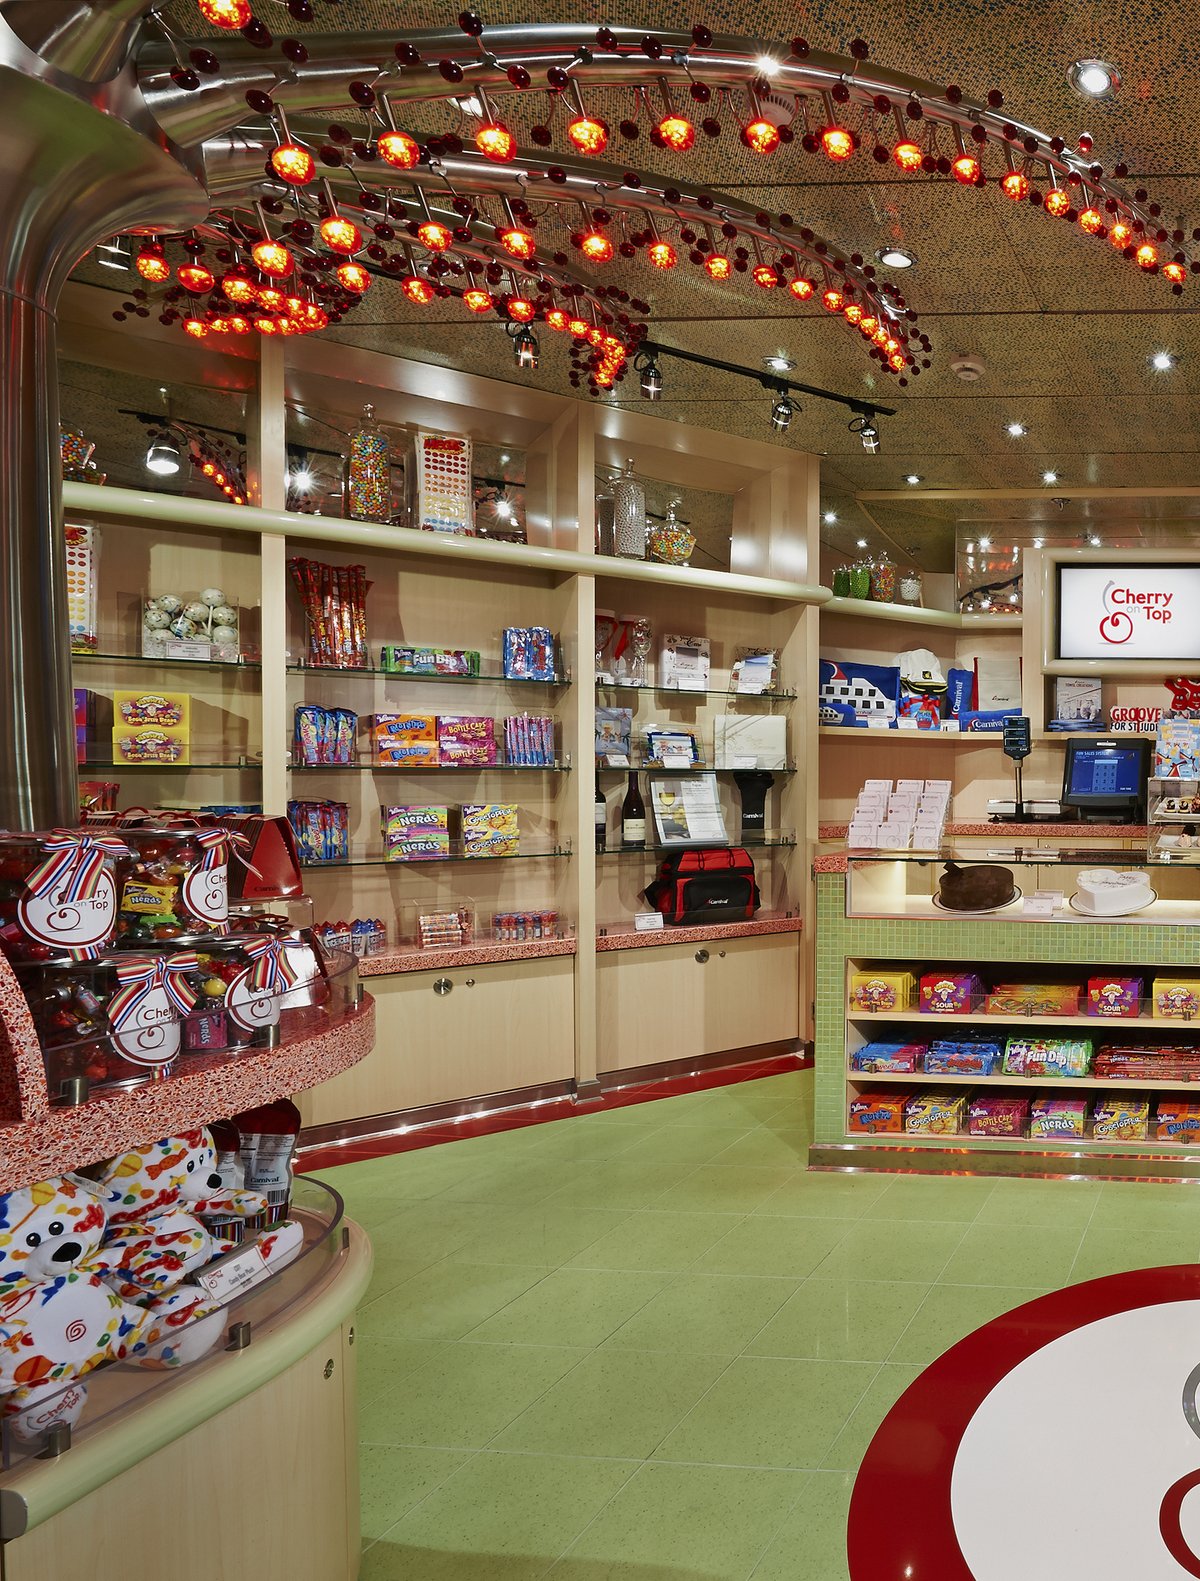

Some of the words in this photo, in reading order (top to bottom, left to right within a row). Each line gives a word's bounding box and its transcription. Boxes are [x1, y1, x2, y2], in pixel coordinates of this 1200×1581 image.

[1111, 588, 1174, 607] Cherry
[1142, 606, 1173, 624] Top
[413, 654, 435, 666] Fun
[953, 681, 963, 711] Carnival
[1111, 707, 1161, 722] GROOVE
[448, 723, 470, 734] BOTTLE
[974, 719, 1004, 729] Carniva
[1110, 722, 1126, 731] FOR
[211, 874, 227, 885] Che
[89, 900, 109, 911] Top
[936, 1001, 954, 1009] SOUR
[1026, 1050, 1047, 1063] Fun
[1047, 1051, 1067, 1068] Dip
[977, 1116, 998, 1128] BOTTLE
[36, 1389, 75, 1424] Cherry
